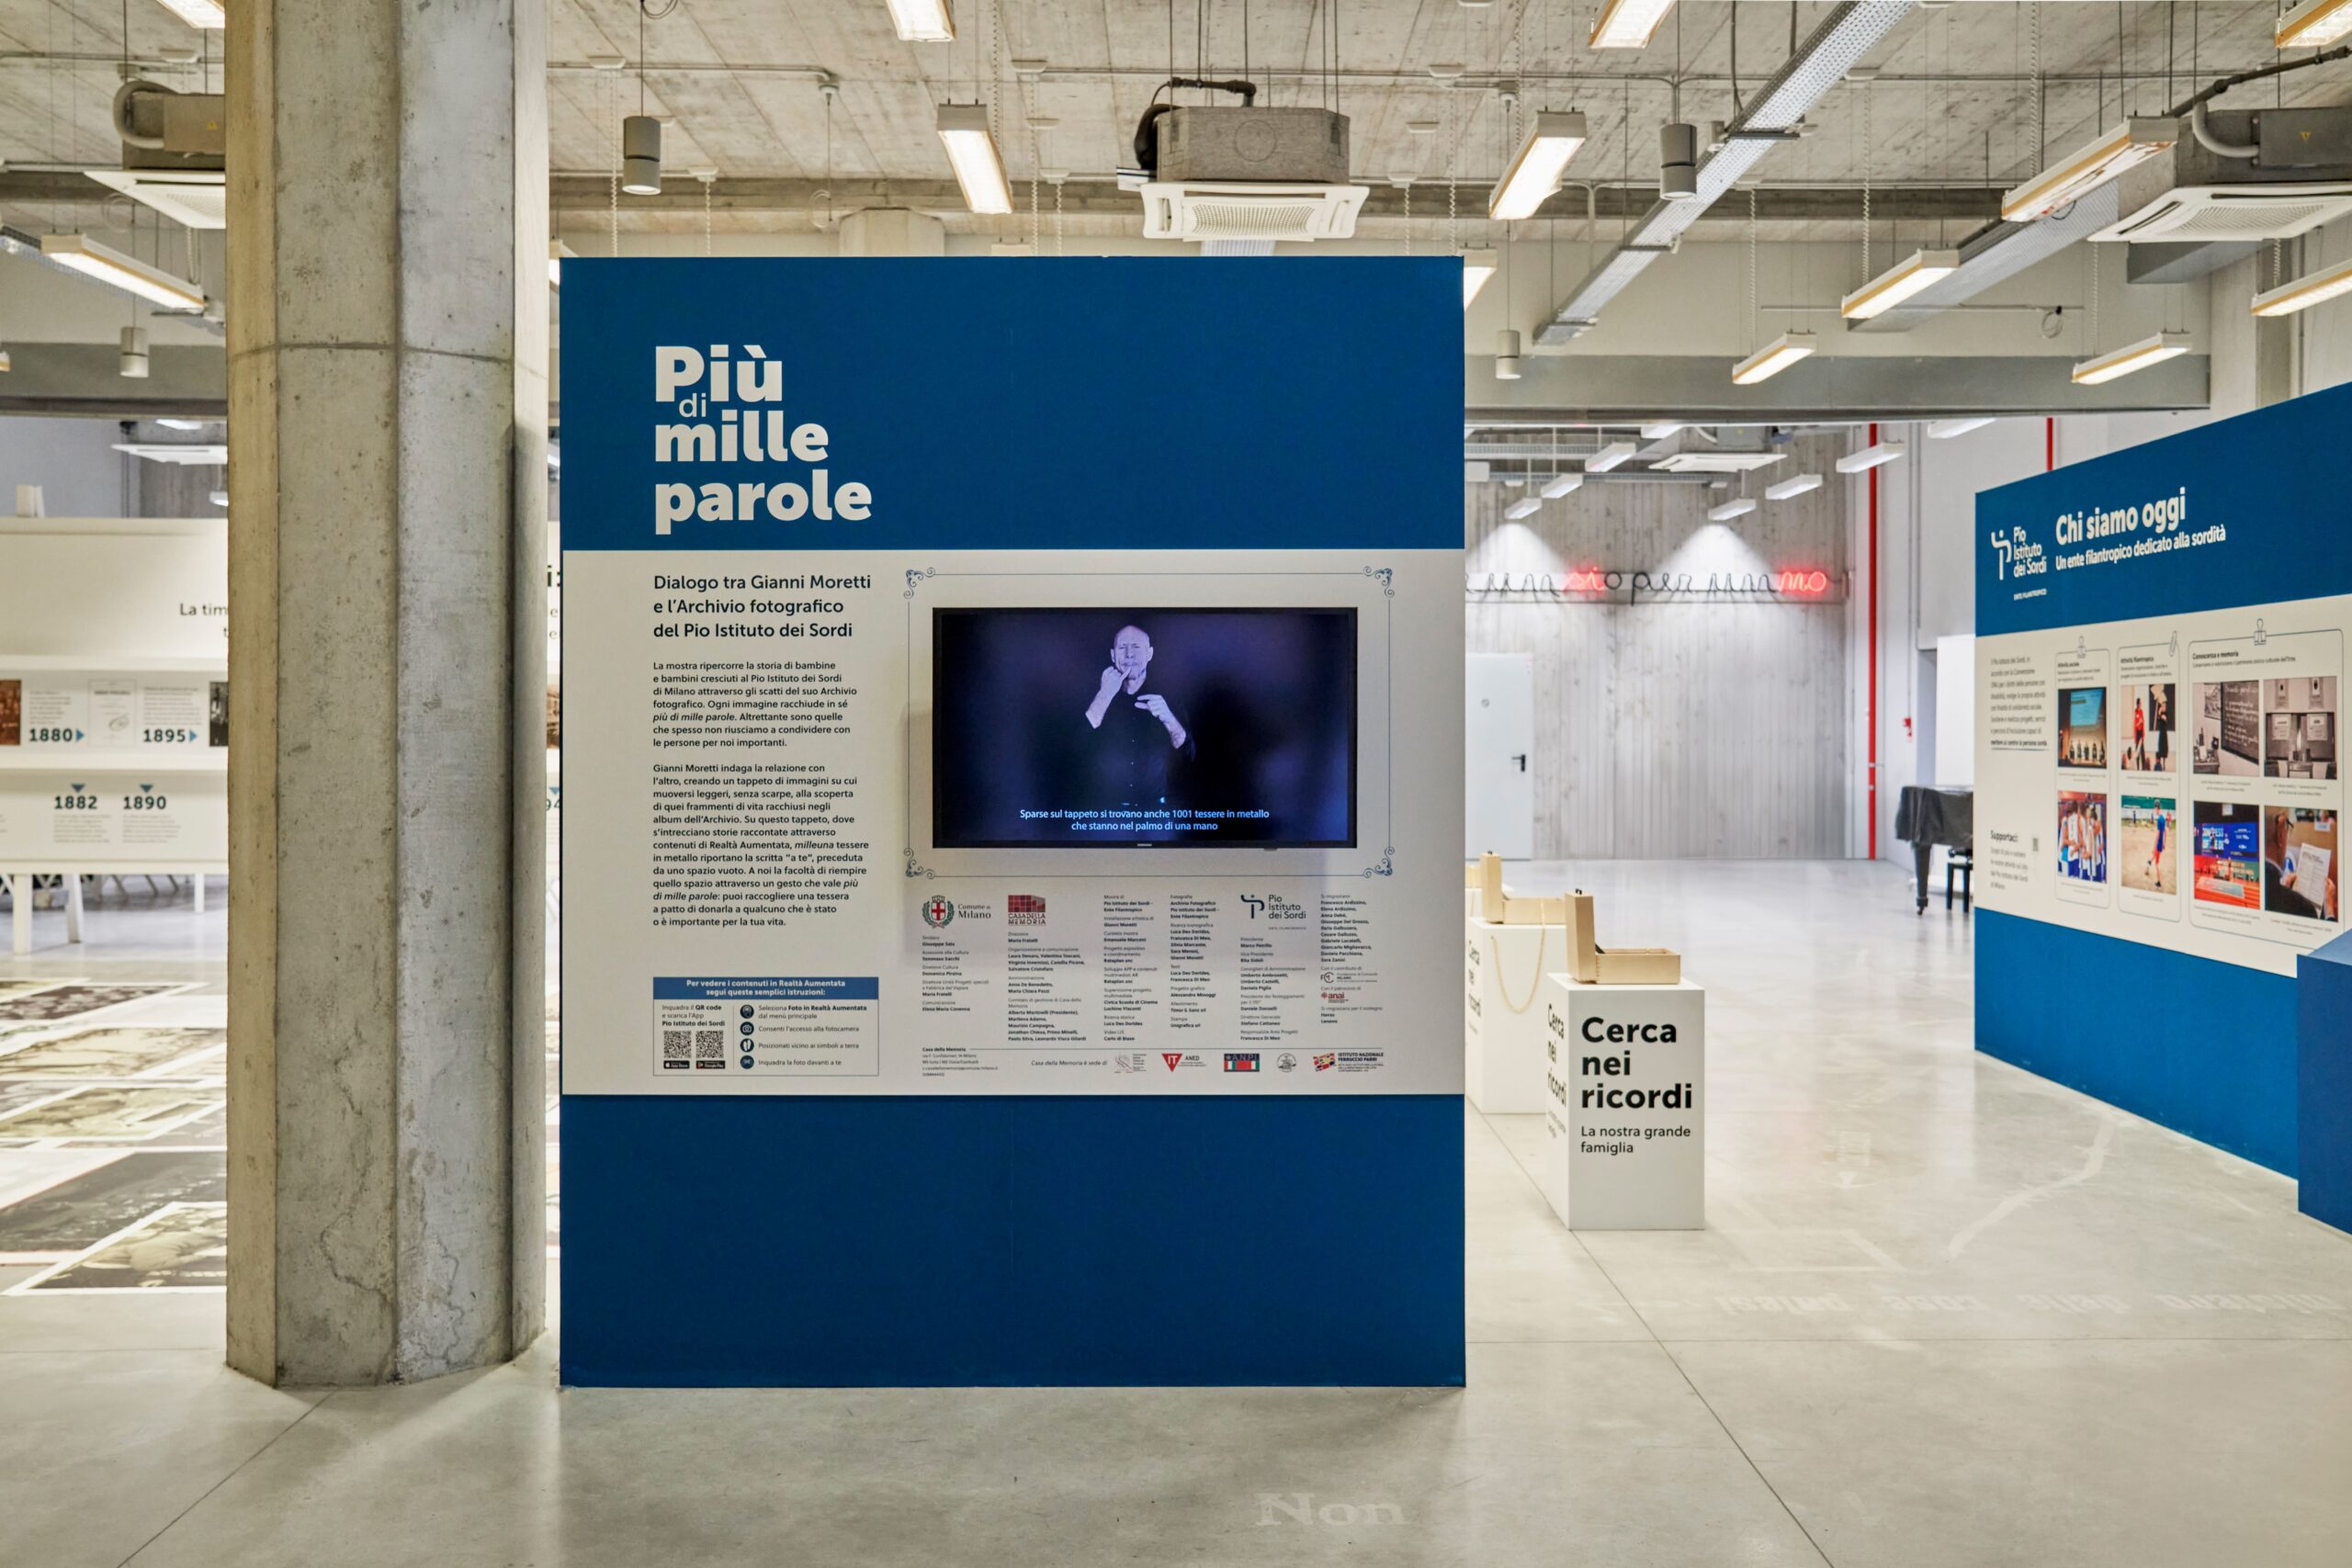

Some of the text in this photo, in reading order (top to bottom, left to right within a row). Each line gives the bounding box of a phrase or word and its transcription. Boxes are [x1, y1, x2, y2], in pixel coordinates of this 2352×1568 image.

[656, 344, 783, 402] Più
[678, 393, 707, 418] di
[655, 409, 829, 462] mille
[655, 468, 872, 536] parole
[2056, 487, 2186, 546] Chi siamo oggi
[2014, 525, 2027, 543] Pio
[2013, 542, 2042, 560] Istituto
[2056, 524, 2226, 570] Un ente filantropico dedicato alla sordità
[2013, 555, 2047, 578] dei Sordi
[654, 575, 871, 592] Dialogo tra Gianni Moretti
[180, 604, 197, 616] La
[653, 599, 843, 616] e l'Archivio fotografico
[653, 623, 852, 637] del Pio Istituto dei Sordi
[700, 661, 744, 672] ripercorre
[746, 661, 754, 670] la
[756, 661, 782, 670] storia
[784, 661, 793, 670] di
[795, 661, 836, 670] bambine
[661, 674, 698, 682] bambini
[700, 674, 739, 682] cresciuti
[741, 674, 749, 682] al
[751, 674, 765, 682] Pio
[767, 674, 799, 682] Istituto
[801, 674, 816, 682] dei
[819, 674, 842, 682] Sordi
[653, 687, 662, 695] di
[664, 687, 695, 695] Milano
[745, 687, 757, 697] gli
[759, 687, 783, 695] scatti
[785, 687, 799, 695] del
[820, 686, 857, 695] Archivio
[653, 699, 705, 710] fotografico.
[707, 700, 730, 710] Ogni
[732, 700, 778, 710] immagine
[780, 700, 825, 708] racchiude
[838, 699, 848, 708] sé
[652, 712, 668, 723] più
[670, 713, 679, 721] di
[681, 713, 704, 721] mille
[705, 713, 737, 723] parole.
[739, 713, 788, 721] Altrettante
[814, 712, 842, 723] quelle
[29, 728, 73, 742] 1880
[143, 728, 186, 743] 1895
[652, 726, 670, 734] che
[672, 728, 703, 736] spesso
[724, 726, 769, 734] riusciamo
[778, 725, 831, 734] condividere
[653, 739, 786, 749] le persone per noi importanti.
[54, 795, 98, 810] 1882
[123, 795, 166, 810] 1890
[1020, 809, 1048, 820] Sparse
[1050, 809, 1062, 818] sul
[1064, 810, 1099, 819] tappeto
[1100, 809, 1107, 818] si
[1108, 810, 1142, 818] trovano
[1144, 809, 1170, 818] anche
[1172, 809, 1192, 818] 1001
[1237, 809, 1270, 818] metallo
[1071, 821, 1088, 830] che
[1089, 822, 1119, 830] stanno
[1120, 821, 1134, 830] nel
[1136, 821, 1163, 832] palmo
[1164, 821, 1173, 830] di
[1268, 895, 1283, 903] Pio
[958, 910, 991, 919] Milano
[1268, 903, 1301, 911] Istituto
[1268, 911, 1306, 919] dei Sordi
[1547, 1003, 1565, 1040] Cerca
[1581, 1017, 1677, 1043] Cerca
[1547, 1041, 1557, 1064] nei
[1582, 1050, 1631, 1076] nei
[1547, 1066, 1567, 1107] ricordi
[1582, 1083, 1692, 1109] ricordi
[1581, 1125, 1690, 1140] La nostra grande
[1581, 1141, 1634, 1156] famiglia
[1253, 1492, 1411, 1527] Non
